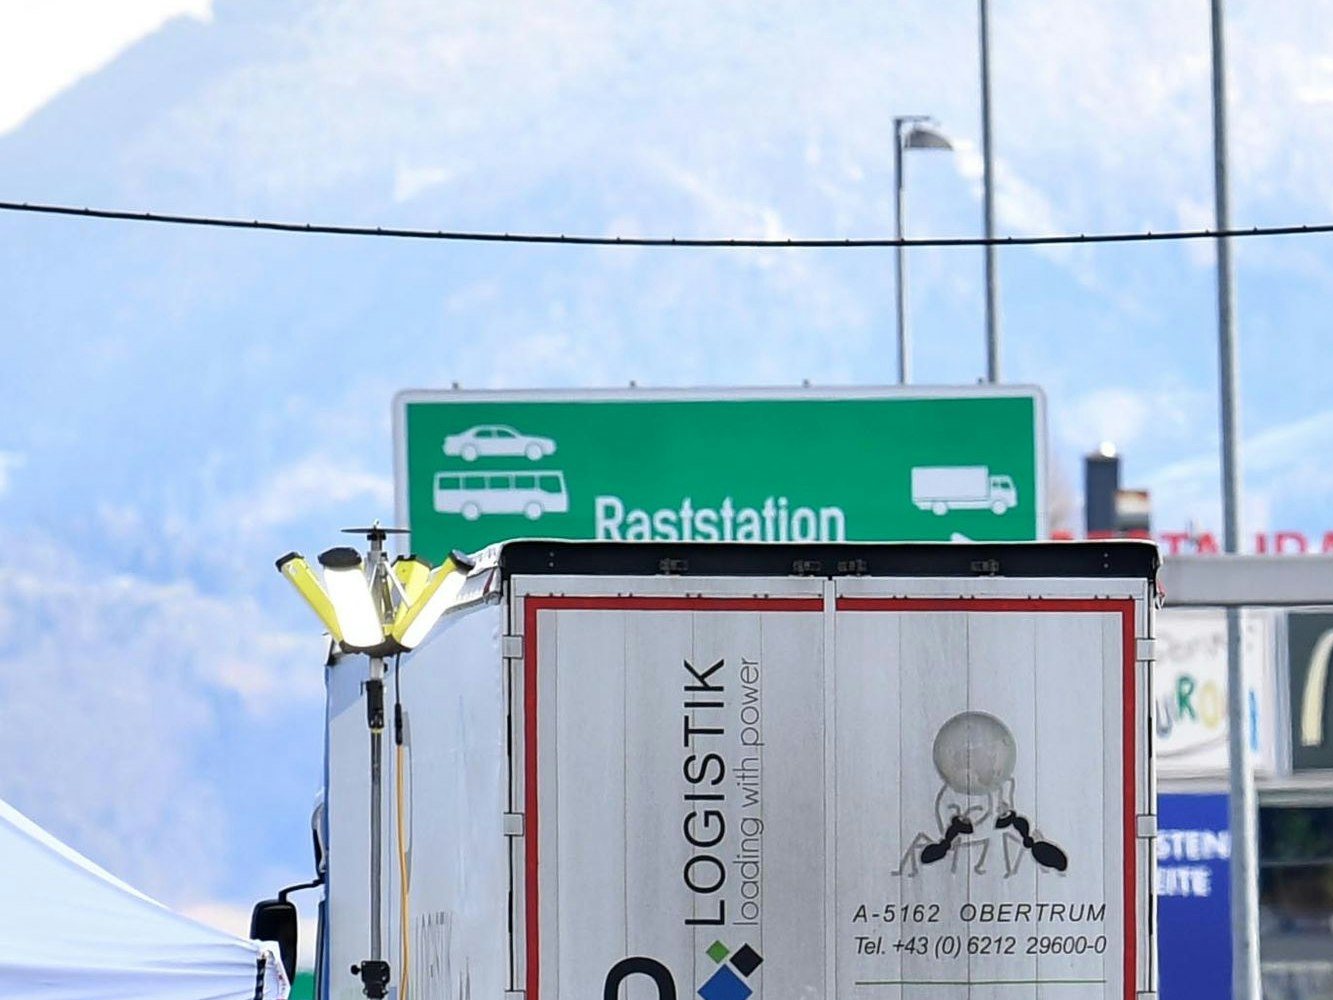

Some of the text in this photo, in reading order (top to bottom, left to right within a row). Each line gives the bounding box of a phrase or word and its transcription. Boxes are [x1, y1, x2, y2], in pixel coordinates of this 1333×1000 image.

[594, 494, 847, 541] Raststation
[683, 657, 727, 926] LOGISTIK
[732, 656, 765, 926] loading with power
[852, 902, 1107, 924] A-5162 OBERTRUM
[854, 935, 1107, 960] Tel. +43 (0) 6212 29600-0
